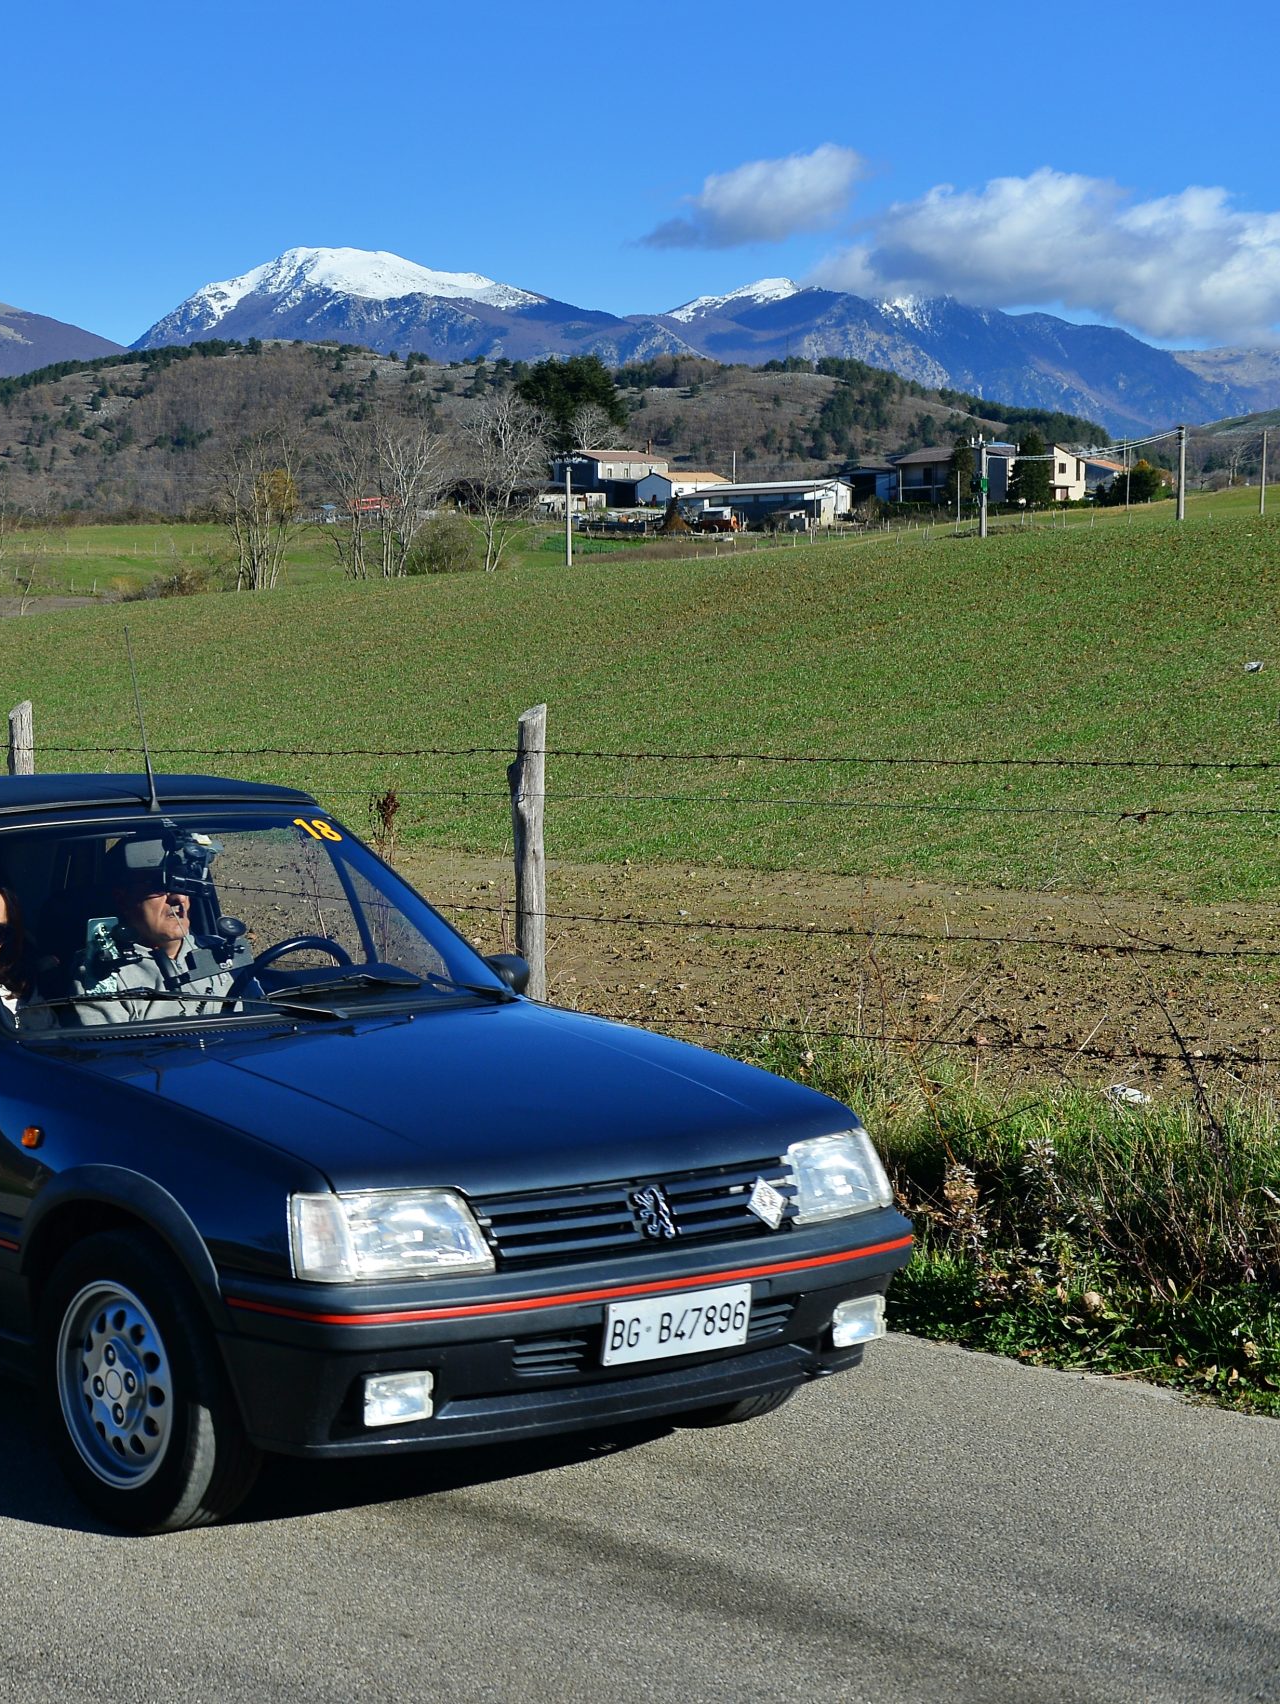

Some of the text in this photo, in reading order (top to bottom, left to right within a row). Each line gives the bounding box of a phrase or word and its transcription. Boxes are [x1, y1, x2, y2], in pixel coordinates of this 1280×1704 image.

[293, 818, 342, 842] 18
[611, 1300, 746, 1351] BG B47896
